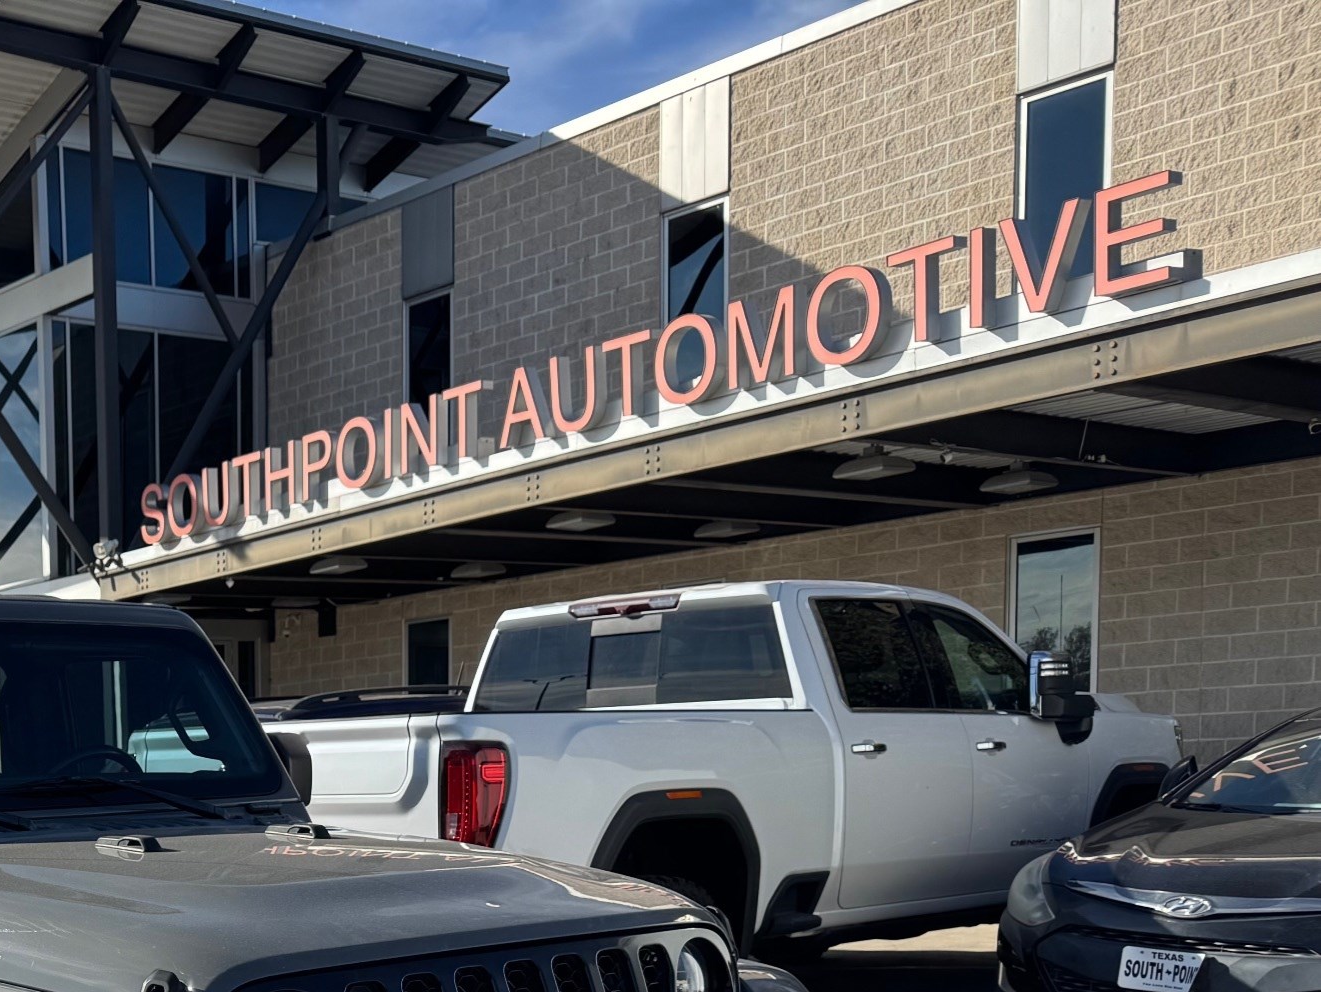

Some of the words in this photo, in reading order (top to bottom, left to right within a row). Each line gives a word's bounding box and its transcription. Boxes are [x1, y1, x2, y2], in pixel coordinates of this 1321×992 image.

[140, 380, 484, 546] SOUTHPOINT
[500, 169, 1176, 449] AUTOMOTIVE
[1151, 951, 1184, 962] TEXAS
[1124, 959, 1164, 981] SOUTH
